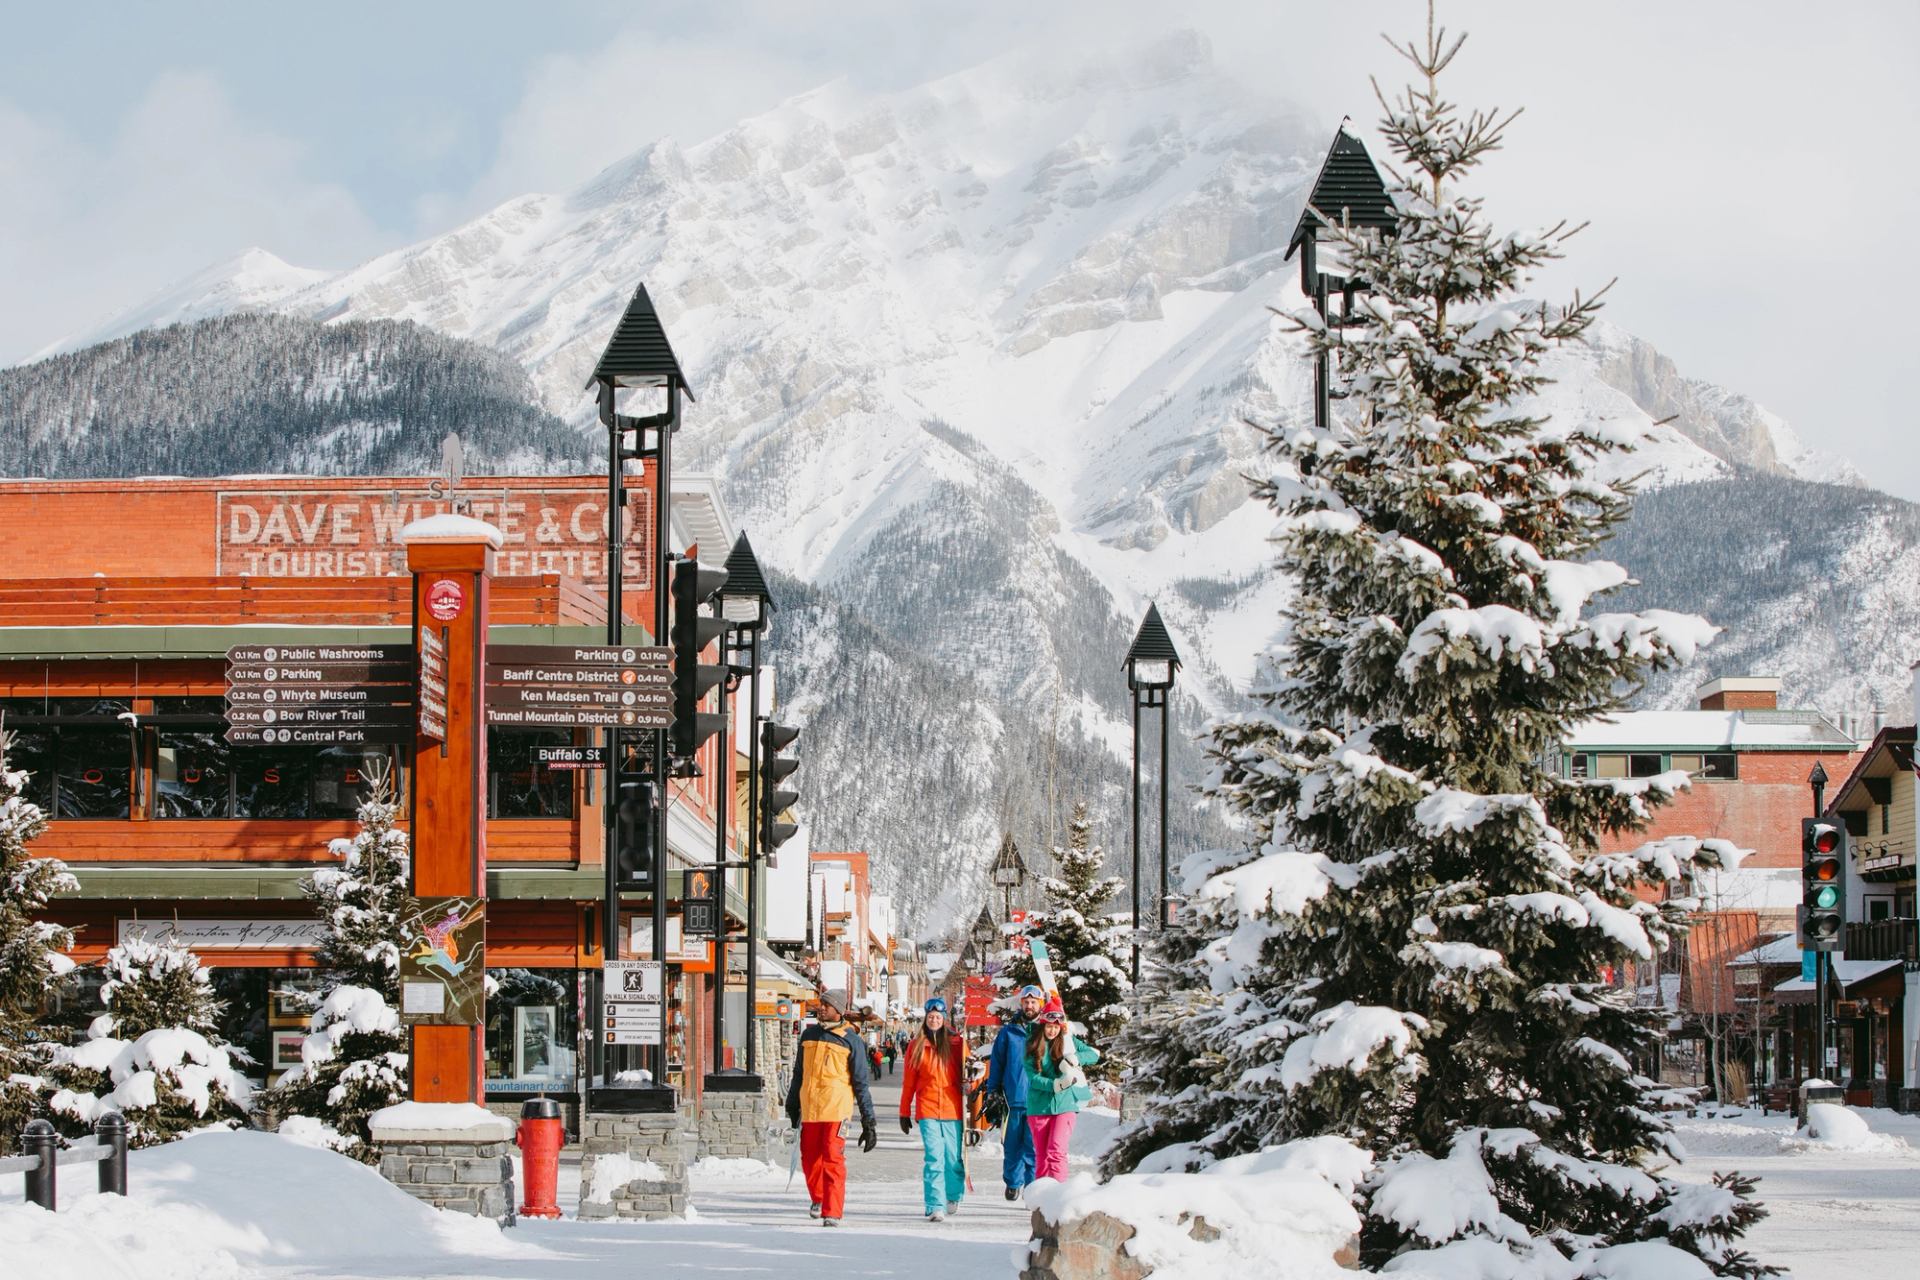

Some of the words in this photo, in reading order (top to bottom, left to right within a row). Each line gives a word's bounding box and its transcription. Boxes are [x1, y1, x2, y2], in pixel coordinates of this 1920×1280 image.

[228, 503, 360, 544] DAVE
[535, 507, 564, 543] &
[243, 551, 389, 577] TOURIST
[235, 651, 246, 659] 0.1
[247, 651, 261, 659] Km
[280, 649, 315, 659] Public
[319, 649, 384, 659] Washrooms
[575, 649, 619, 663] Parking
[640, 652, 652, 660] 0.1
[653, 652, 667, 660] Km
[235, 671, 246, 679] 0.1
[247, 671, 261, 679] Km
[280, 668, 322, 680] Parking
[503, 670, 533, 681] Banff
[536, 671, 573, 682] Centre
[577, 671, 619, 683] District
[637, 674, 651, 682] 0.4
[652, 674, 667, 683] Km
[232, 692, 245, 700] 0.2
[247, 692, 260, 700] Km
[281, 690, 317, 702] Whyte
[320, 690, 367, 700] Museum
[521, 690, 543, 701] Ken
[546, 691, 590, 702] Madsen
[593, 692, 619, 702] Trail
[637, 694, 651, 702] 0.6
[652, 694, 667, 703] Km
[231, 712, 245, 720] 0.2
[246, 712, 260, 720] Km
[280, 711, 304, 720] Bow
[307, 711, 337, 720] River
[340, 710, 365, 720] Trail
[487, 711, 523, 722] Tunnel
[525, 711, 575, 723] Mountain
[578, 712, 618, 724] District
[637, 715, 651, 723] 0.9
[652, 715, 667, 724] Km
[233, 732, 246, 740] 0.1
[246, 732, 260, 740] Km
[293, 730, 335, 741] Central
[338, 730, 364, 740] Park
[538, 749, 583, 760] Buffalo
[586, 749, 601, 760] St
[605, 993, 612, 1001] ON
[613, 993, 628, 1001] WALK
[629, 993, 646, 1001] SIGNAL
[647, 993, 660, 1001] ONLY
